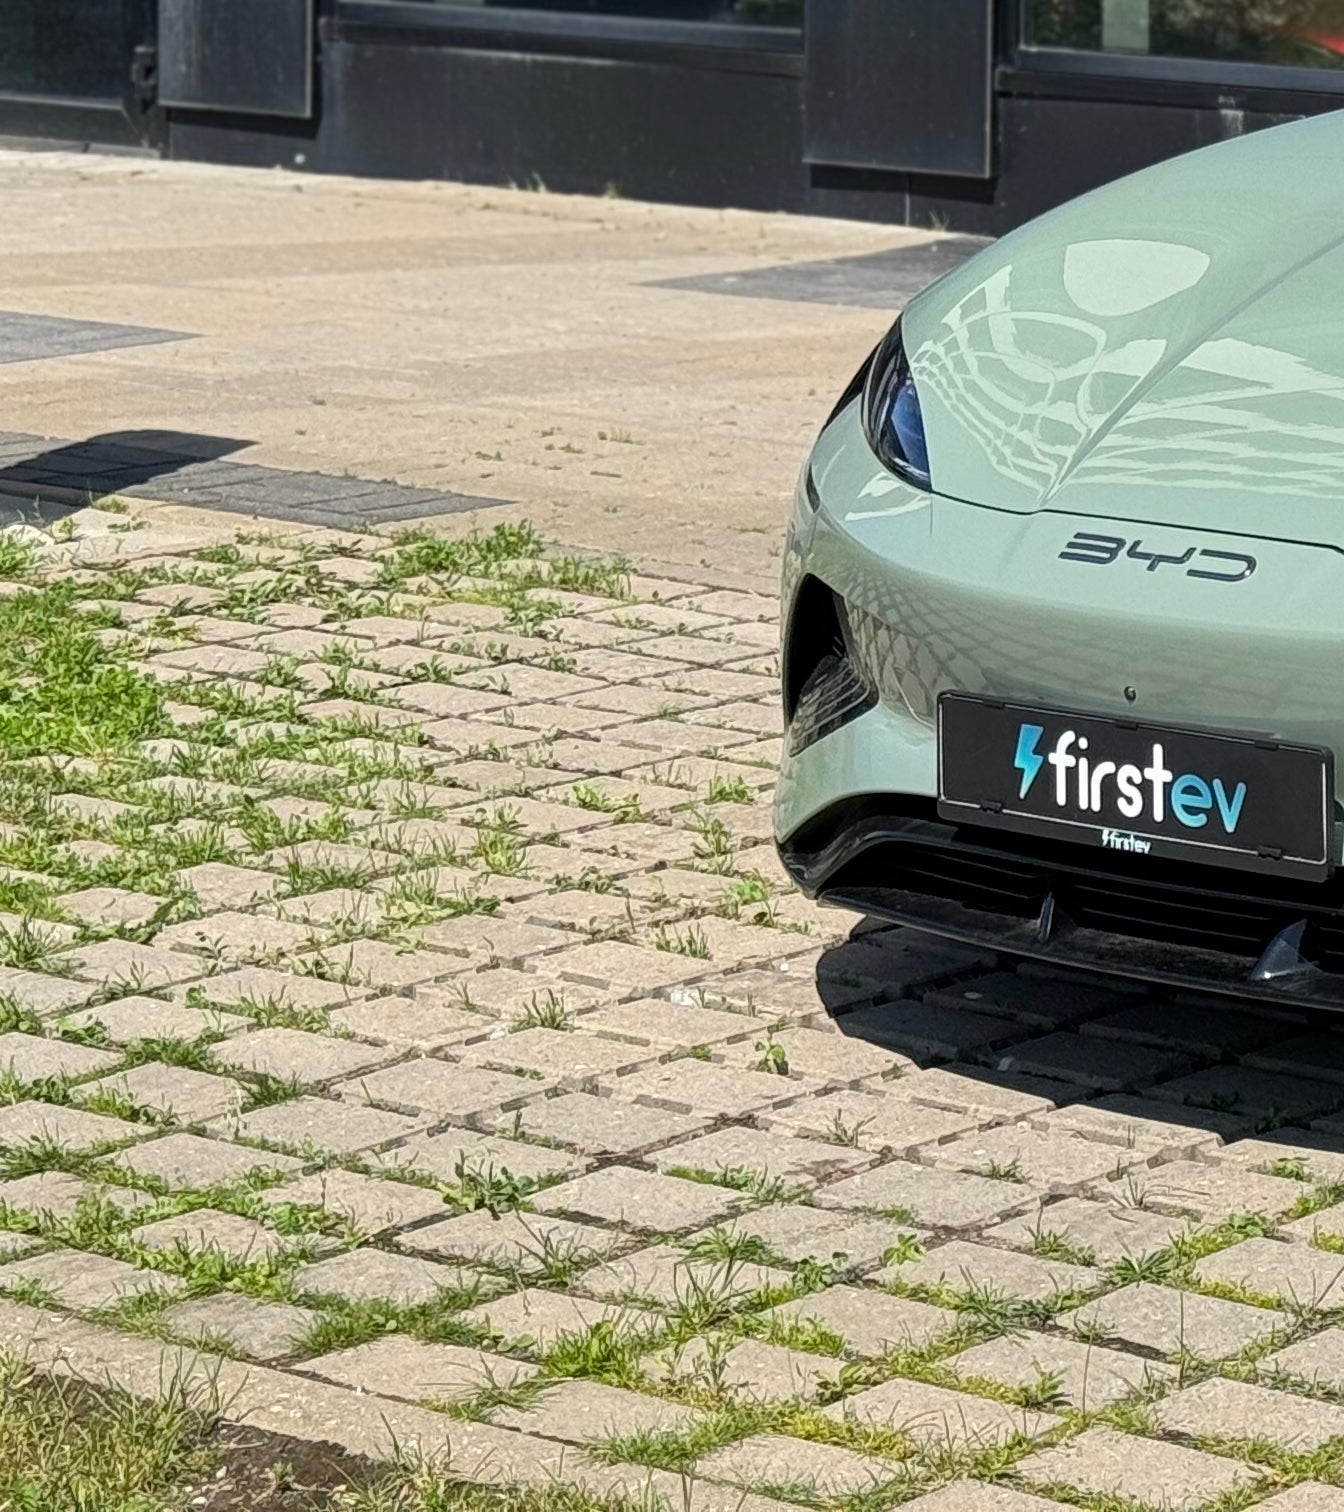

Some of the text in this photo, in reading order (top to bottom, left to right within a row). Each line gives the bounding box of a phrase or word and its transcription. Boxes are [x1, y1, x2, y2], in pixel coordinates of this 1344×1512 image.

[1057, 532, 1257, 582] BYD
[1048, 730, 1247, 833] firstev
[1110, 829, 1151, 854] firstev
